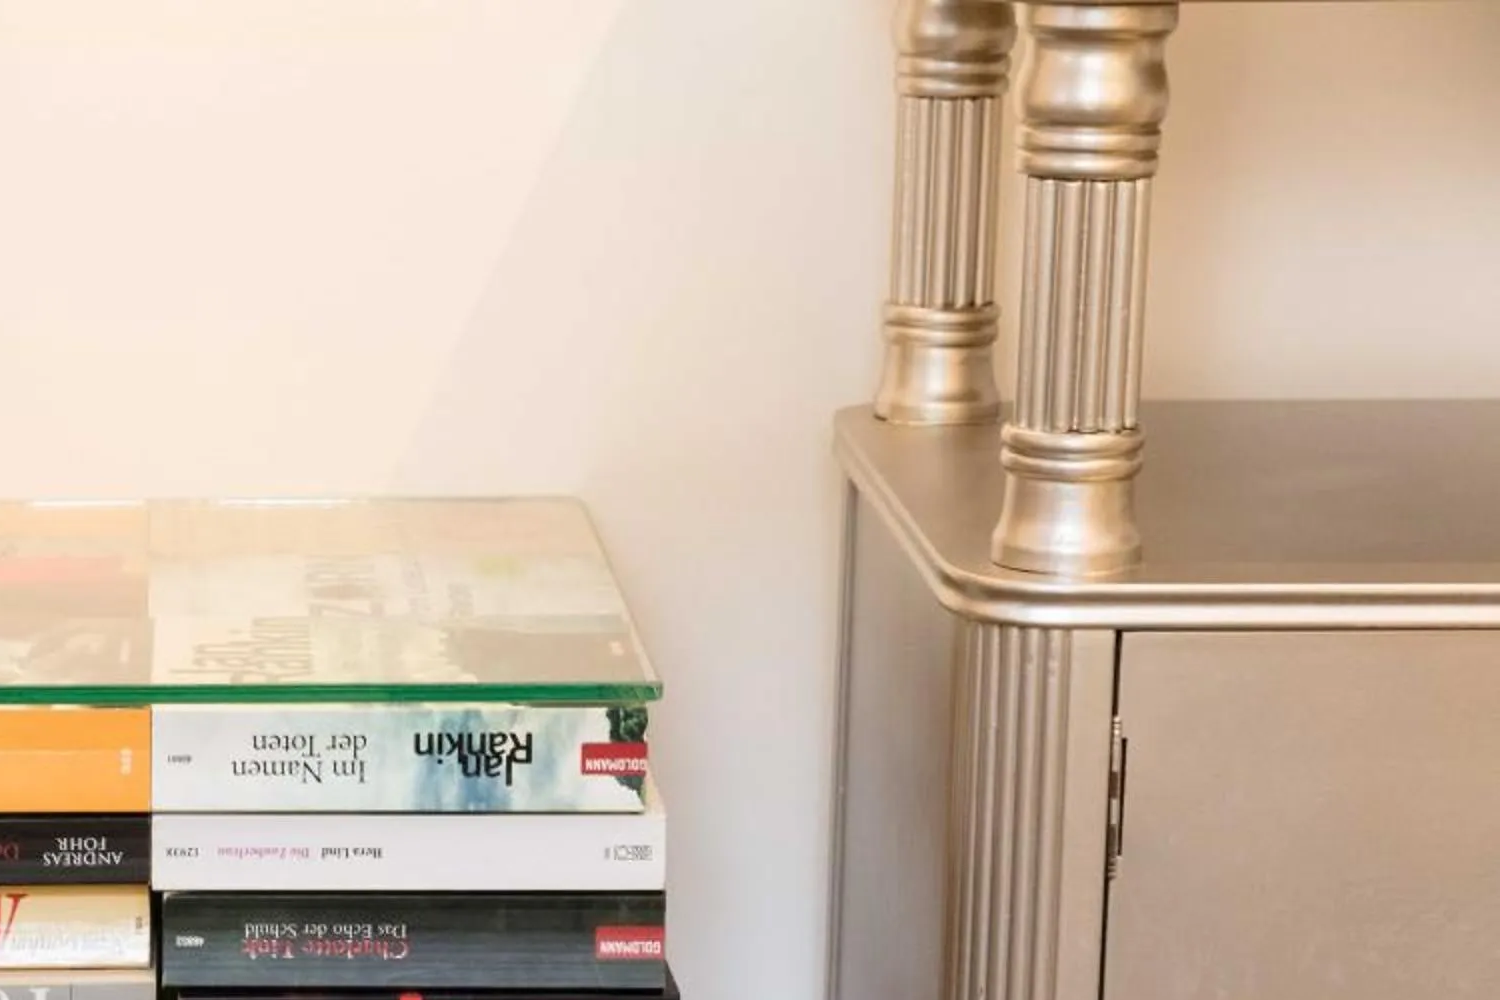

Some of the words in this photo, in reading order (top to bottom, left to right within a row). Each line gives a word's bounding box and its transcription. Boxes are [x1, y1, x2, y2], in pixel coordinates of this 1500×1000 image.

[253, 735, 320, 757] Toten
[327, 735, 367, 758] der
[414, 733, 532, 764] Rankin
[232, 761, 322, 783] Namen
[334, 760, 366, 783] Im
[461, 755, 513, 786] Ian
[586, 758, 647, 771] GOLDMANN
[43, 851, 123, 866] ANDREAS
[321, 847, 349, 859] Lind
[353, 847, 382, 859] Hera
[244, 923, 297, 938] Schuld
[304, 923, 327, 938] der
[333, 923, 372, 938] Echo
[380, 923, 406, 938] Das
[241, 940, 294, 960] Link
[301, 940, 408, 960] Charlotte
[600, 941, 661, 954] GOLDMANN
